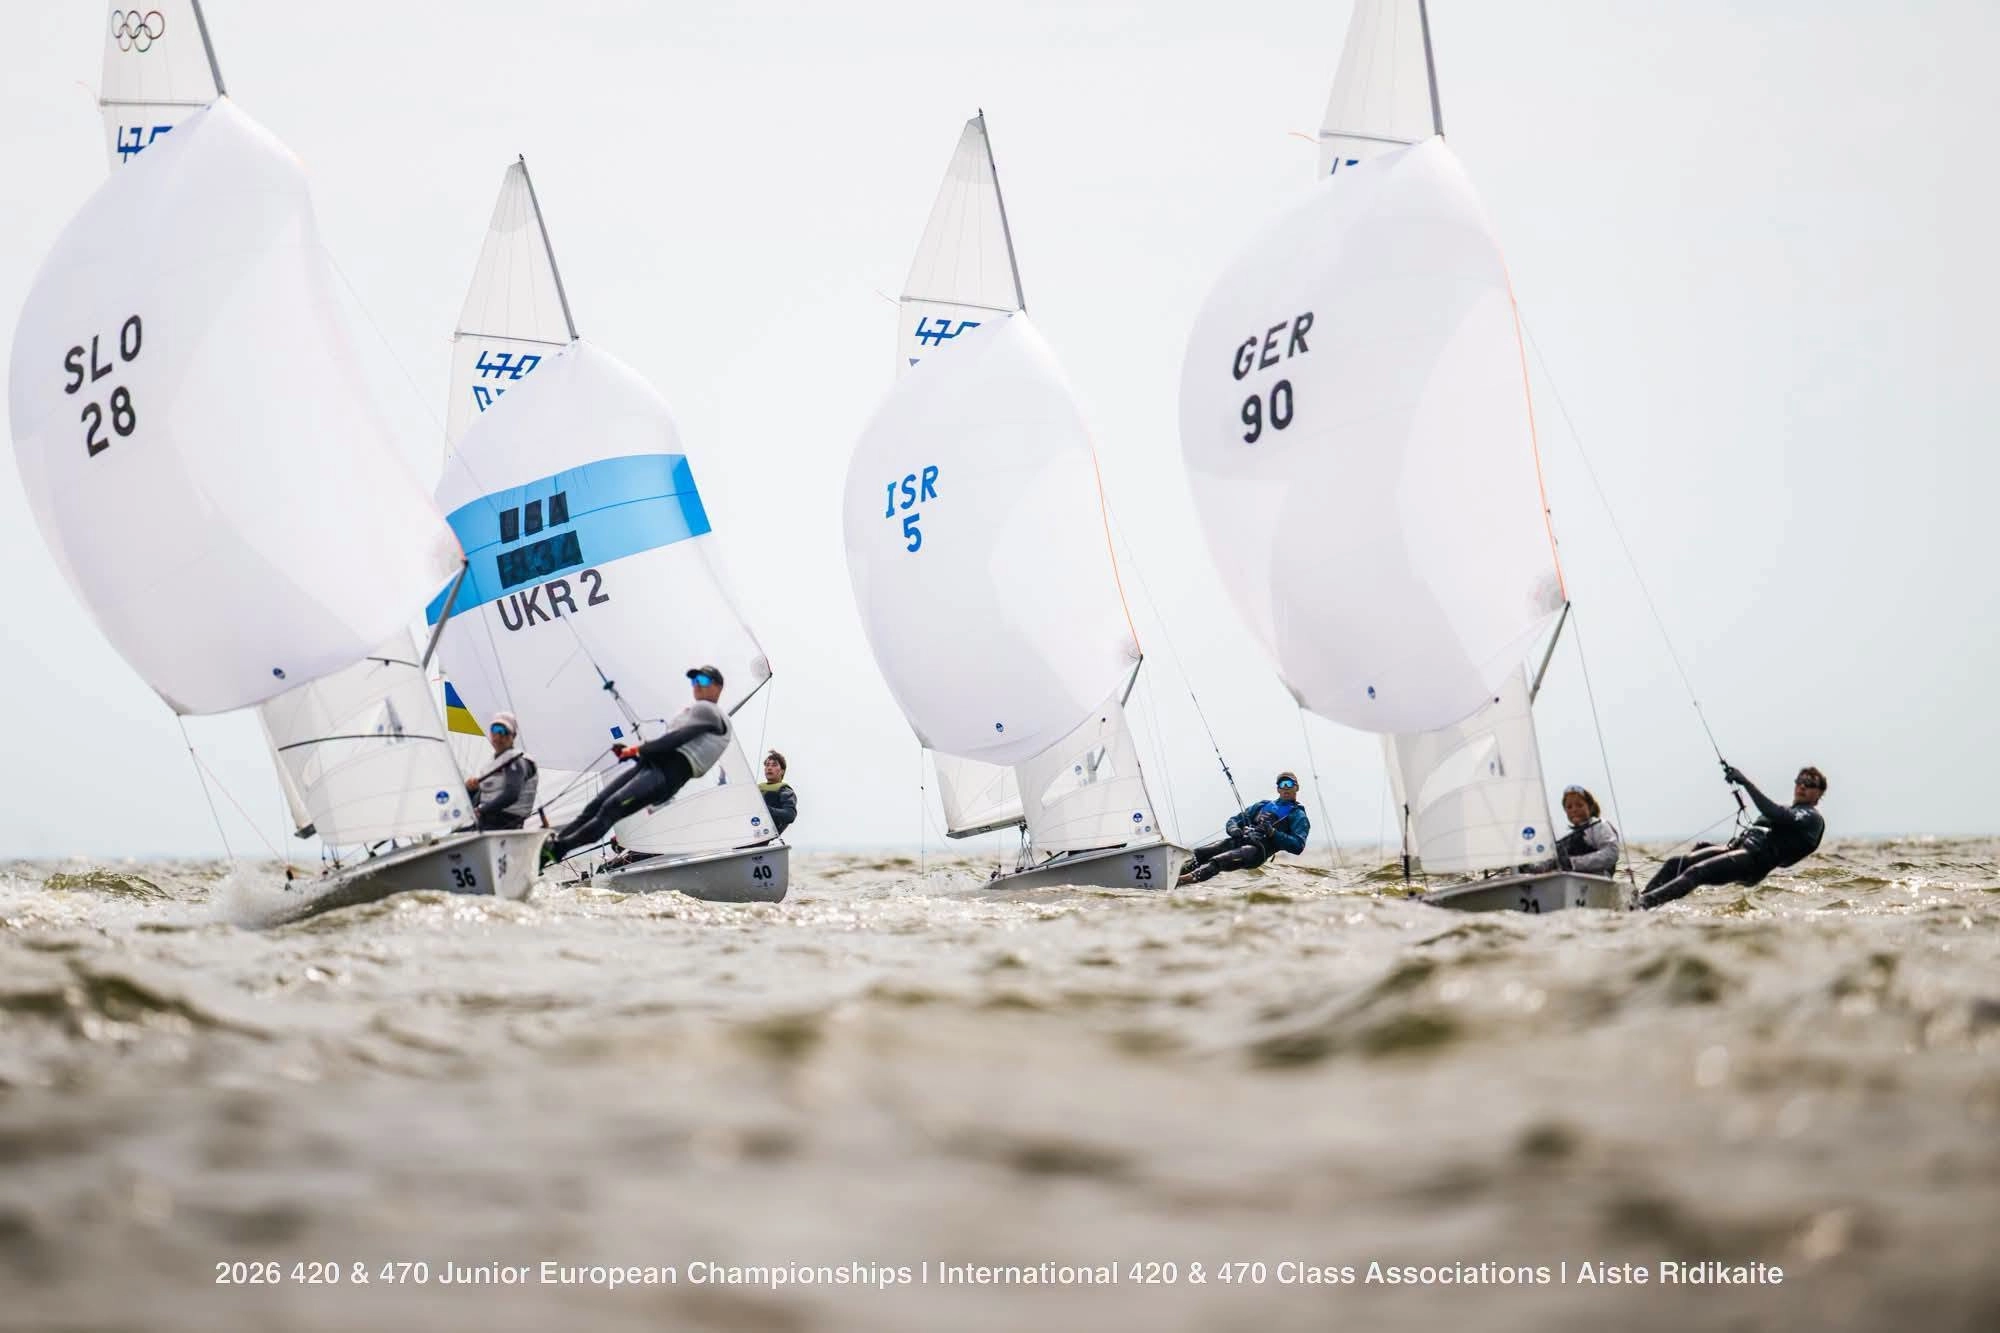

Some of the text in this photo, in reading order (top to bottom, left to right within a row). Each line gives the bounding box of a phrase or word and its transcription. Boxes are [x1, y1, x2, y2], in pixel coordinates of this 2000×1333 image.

[64, 314, 142, 395] SLO
[1232, 310, 1314, 381] GER
[80, 385, 136, 458] 28
[1241, 379, 1294, 444] 90
[885, 465, 939, 519] ISR
[903, 512, 922, 553] 5
[496, 568, 610, 632] UKR 2
[451, 867, 477, 888] 36
[753, 865, 772, 880] 40
[1133, 865, 1152, 880] 25
